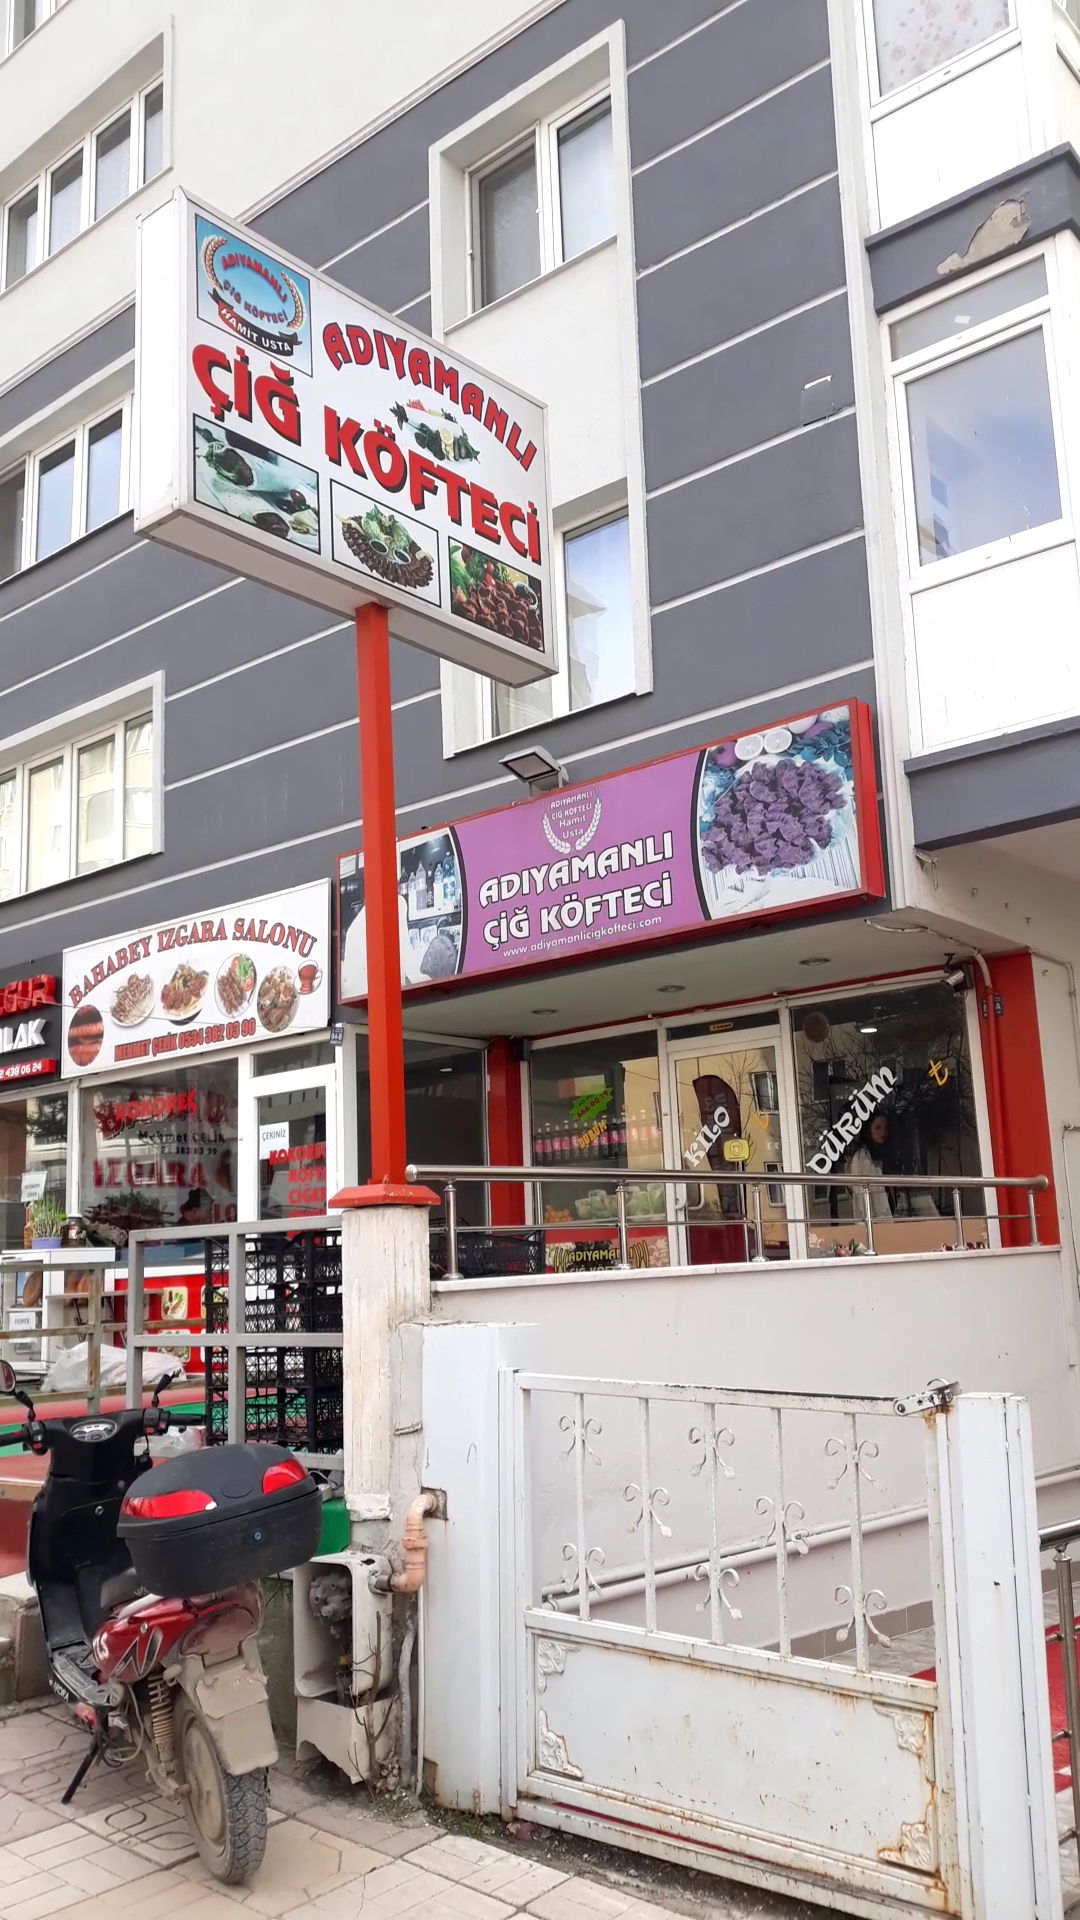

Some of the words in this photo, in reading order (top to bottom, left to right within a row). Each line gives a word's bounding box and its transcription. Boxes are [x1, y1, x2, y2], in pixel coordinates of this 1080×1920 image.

[220, 308, 259, 342] HAMİT
[261, 336, 293, 352] USTA
[323, 321, 537, 472] ADIYAMANLI
[192, 343, 302, 447] ÇİĞ
[324, 405, 542, 567] KÖFTECİ
[550, 790, 593, 810] ADIYAMANLI
[562, 828, 584, 839] Usta
[479, 830, 674, 909] ADIYAMANLI
[482, 905, 531, 951] ÇİĞ
[540, 871, 673, 934] KÖFTECİ
[502, 915, 662, 958] www.adiyamanlicigkofteci.com
[68, 935, 153, 1009] BAHABEY
[157, 918, 228, 953] IZGARA
[232, 917, 318, 958] SALONU
[114, 1039, 152, 1062] MEHMET
[241, 1017, 257, 1037] 90
[261, 1128, 287, 1141] ÇEKİNİZ
[683, 1106, 730, 1168] KİLO
[805, 1066, 898, 1175] DÜRÜM
